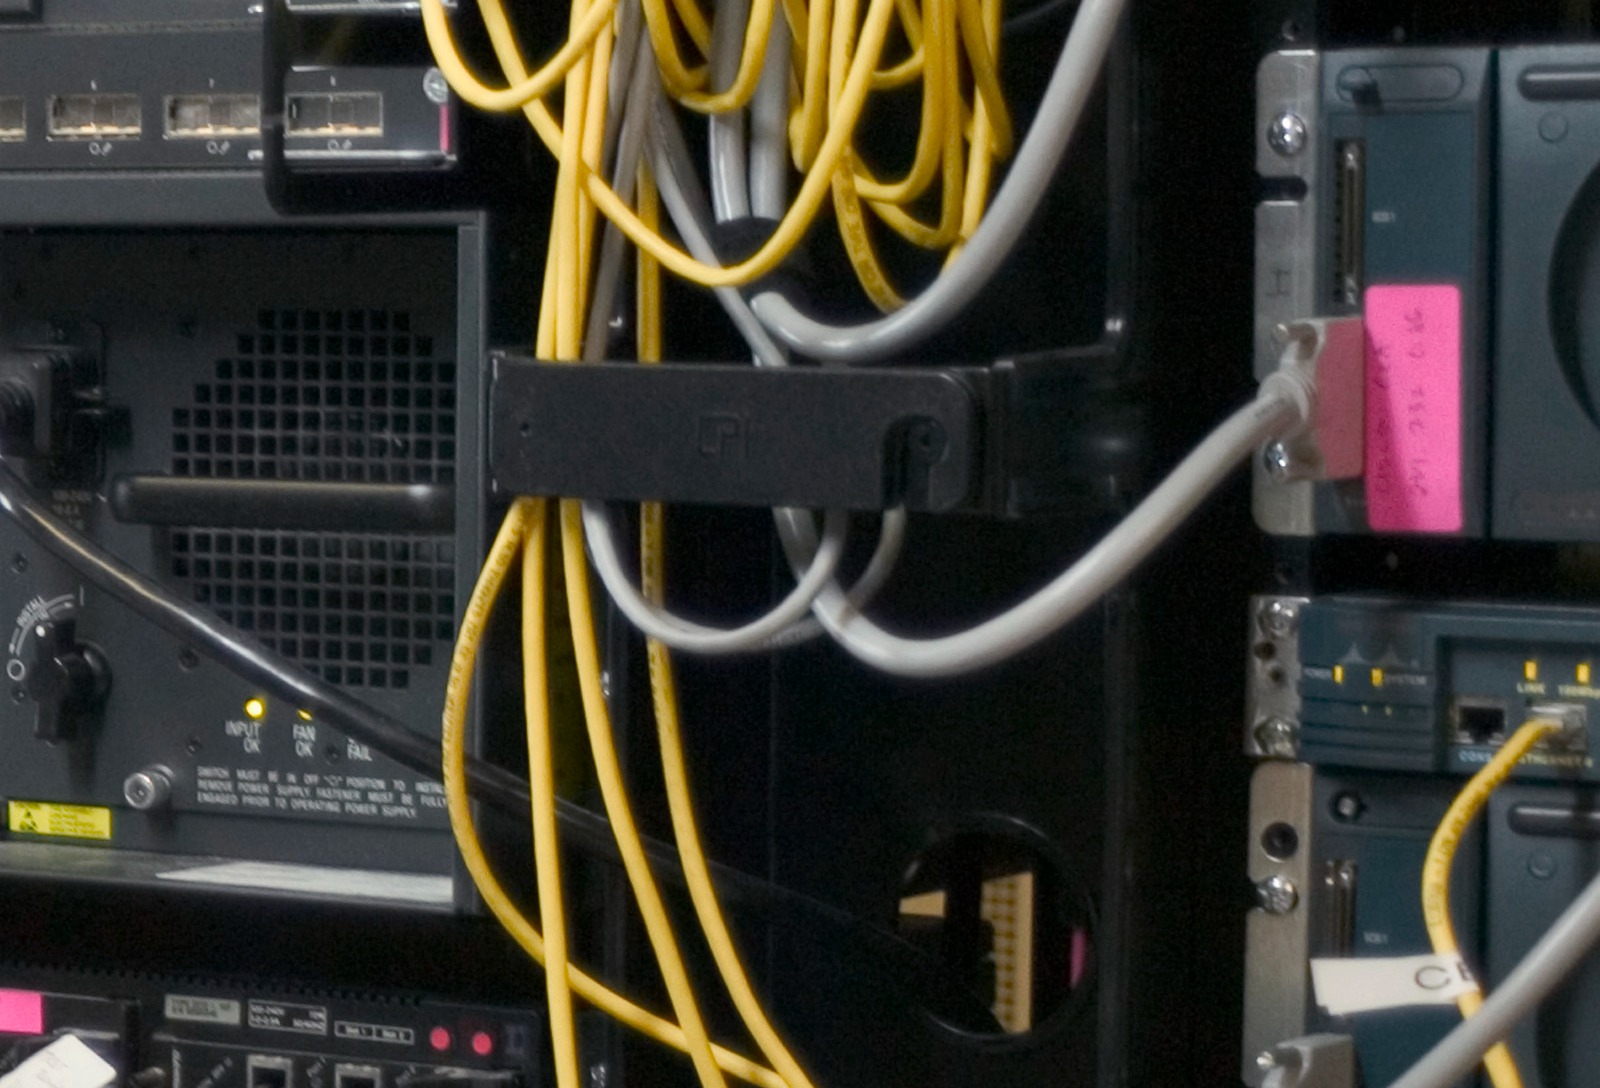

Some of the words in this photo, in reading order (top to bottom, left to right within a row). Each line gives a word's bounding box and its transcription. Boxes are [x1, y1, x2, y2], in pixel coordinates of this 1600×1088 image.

[225, 720, 261, 738] INPUT
[292, 723, 316, 741] FAN
[243, 738, 261, 754] OK
[295, 740, 314, 758] OK
[347, 744, 373, 762] FAIL
